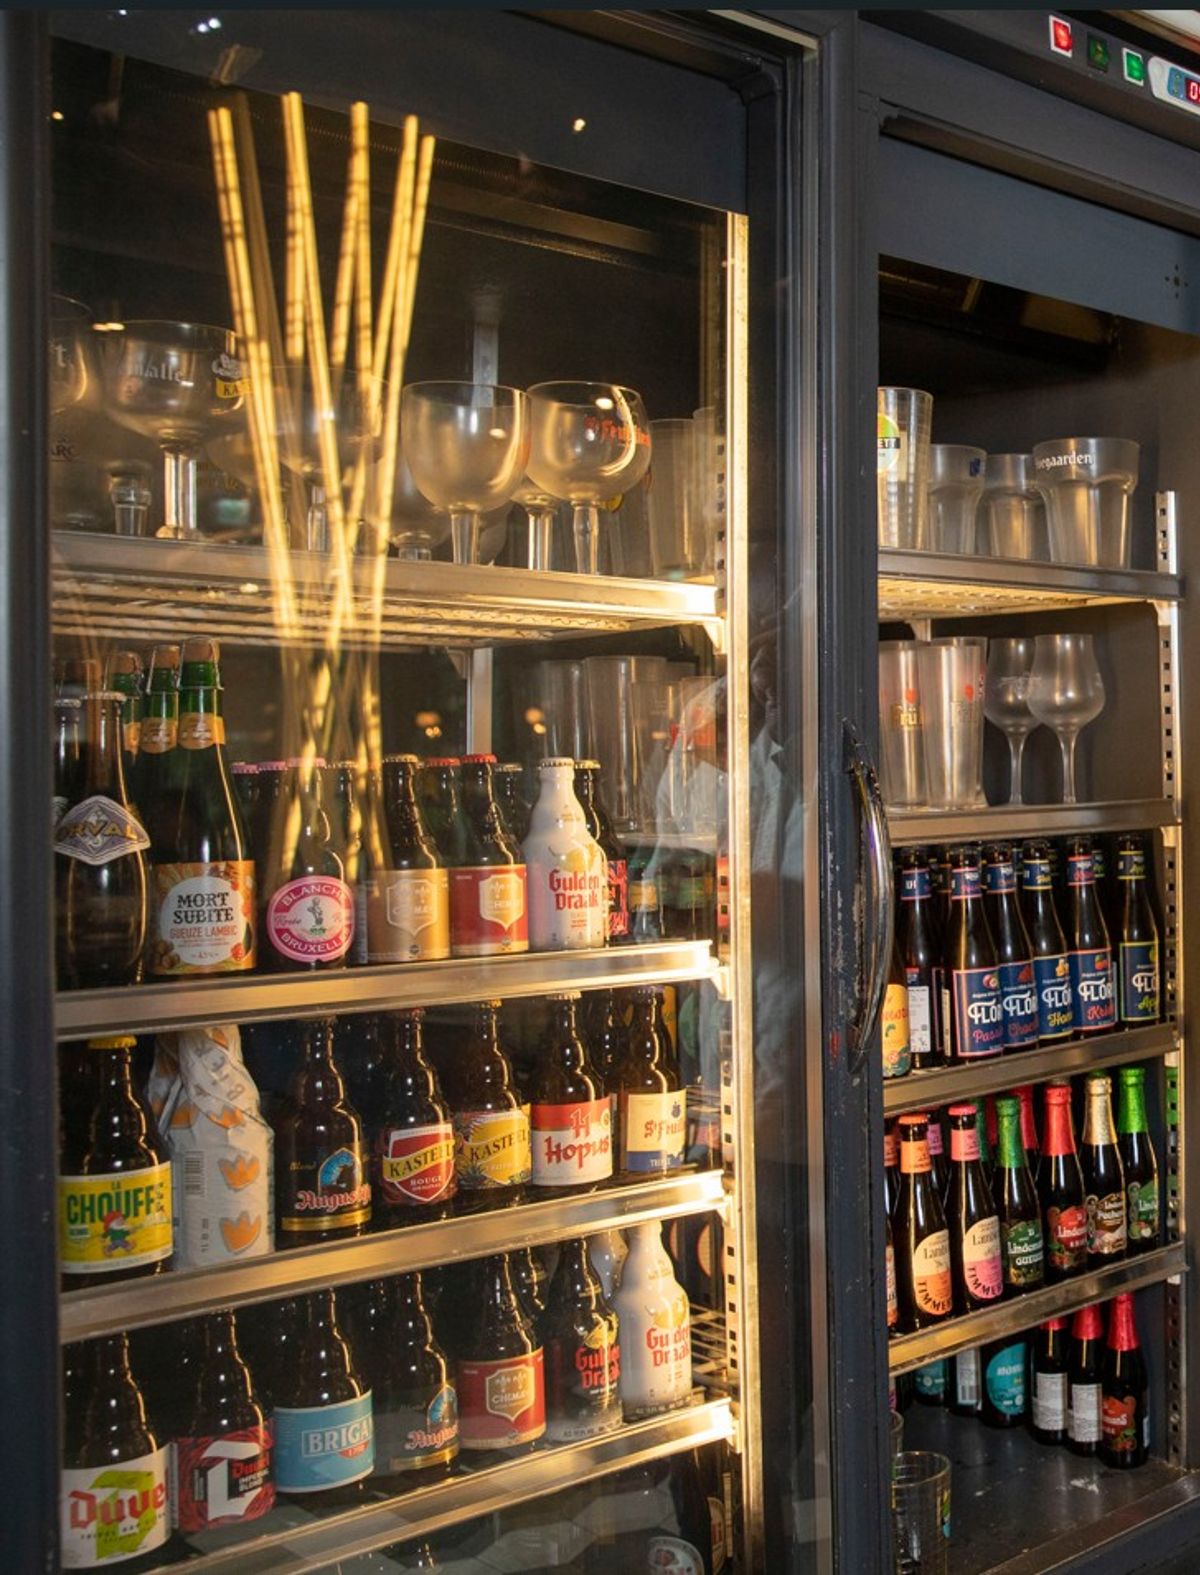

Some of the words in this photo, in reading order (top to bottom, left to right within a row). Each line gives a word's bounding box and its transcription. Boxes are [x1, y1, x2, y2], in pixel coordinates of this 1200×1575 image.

[549, 867, 600, 892] Gulden
[177, 892, 229, 909] MORT
[281, 884, 345, 906] BLANCH
[173, 907, 234, 925] SUBITE
